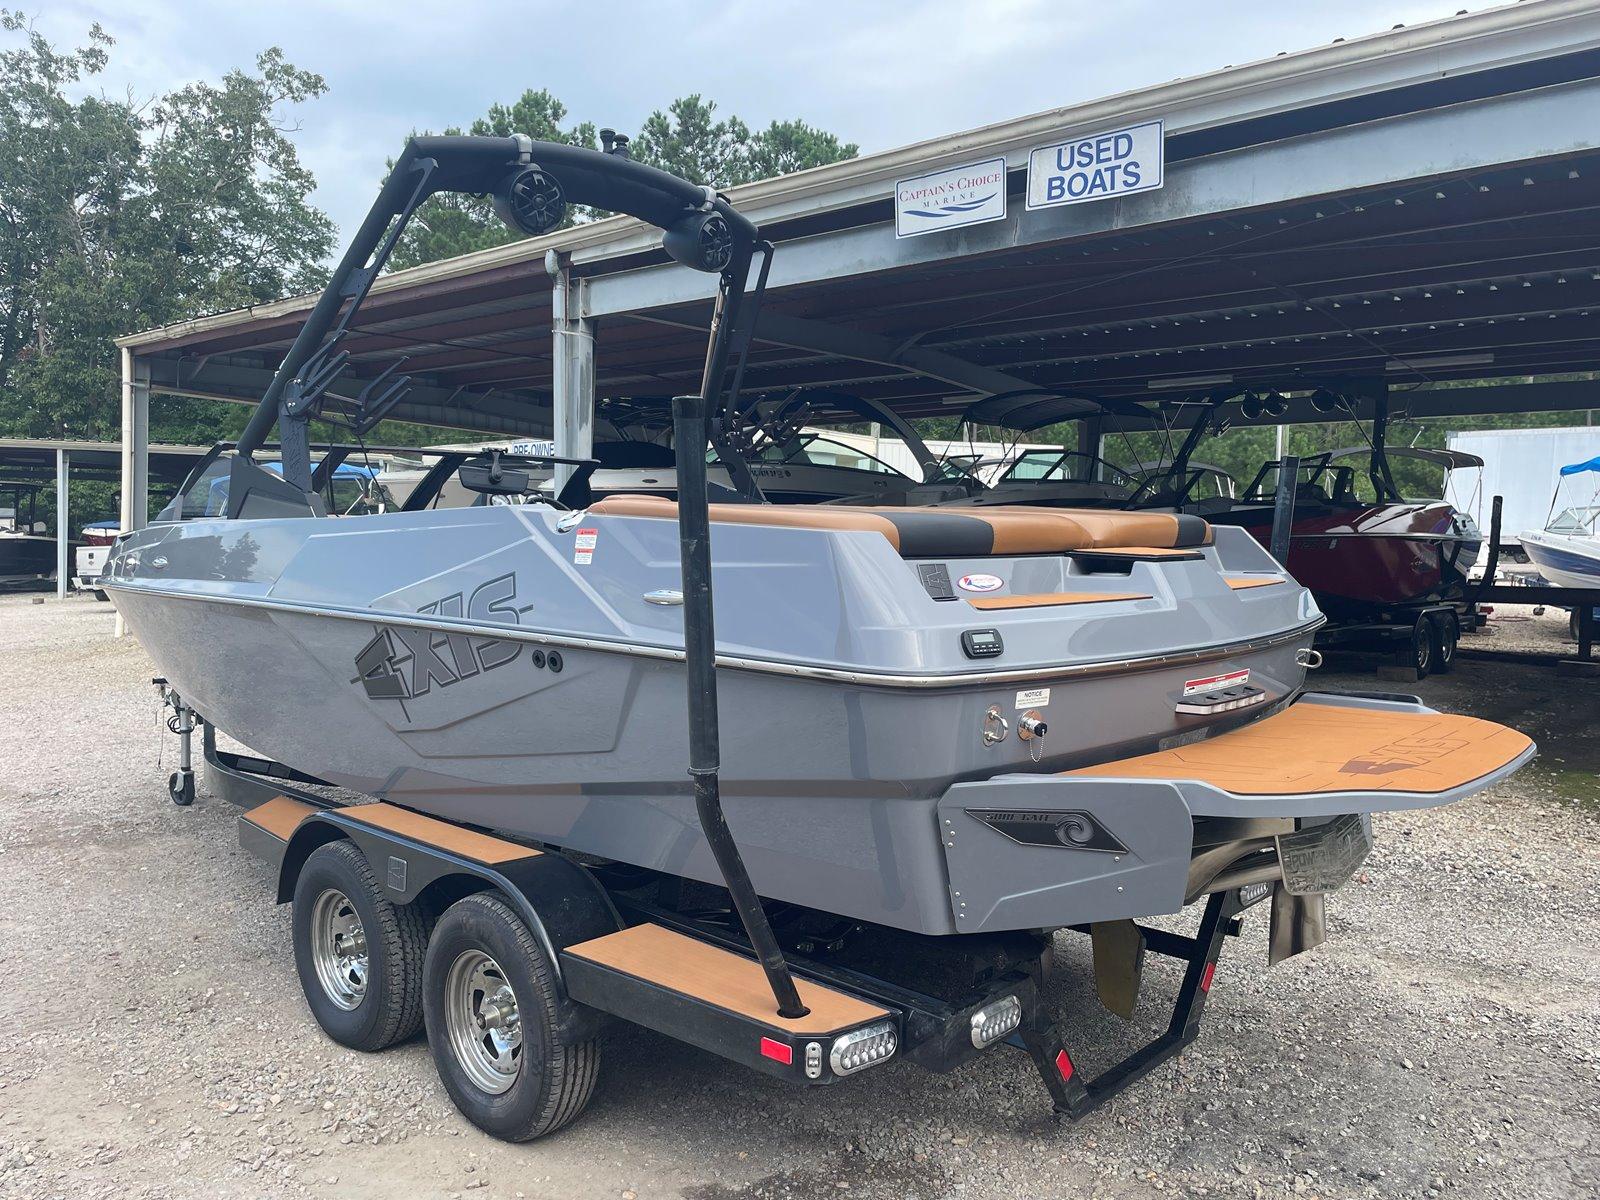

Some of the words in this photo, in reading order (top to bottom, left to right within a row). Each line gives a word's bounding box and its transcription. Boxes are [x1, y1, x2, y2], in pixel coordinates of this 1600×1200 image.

[1056, 133, 1133, 172] USED
[900, 182, 955, 202] CAPTAIN'S
[957, 173, 1001, 190] CHOICE
[1047, 161, 1141, 201] BOATS
[923, 191, 976, 208] MARINE
[513, 443, 554, 457] PRE-OWNE
[354, 571, 524, 700] AXIS
[1024, 690, 1043, 698] NOTICE
